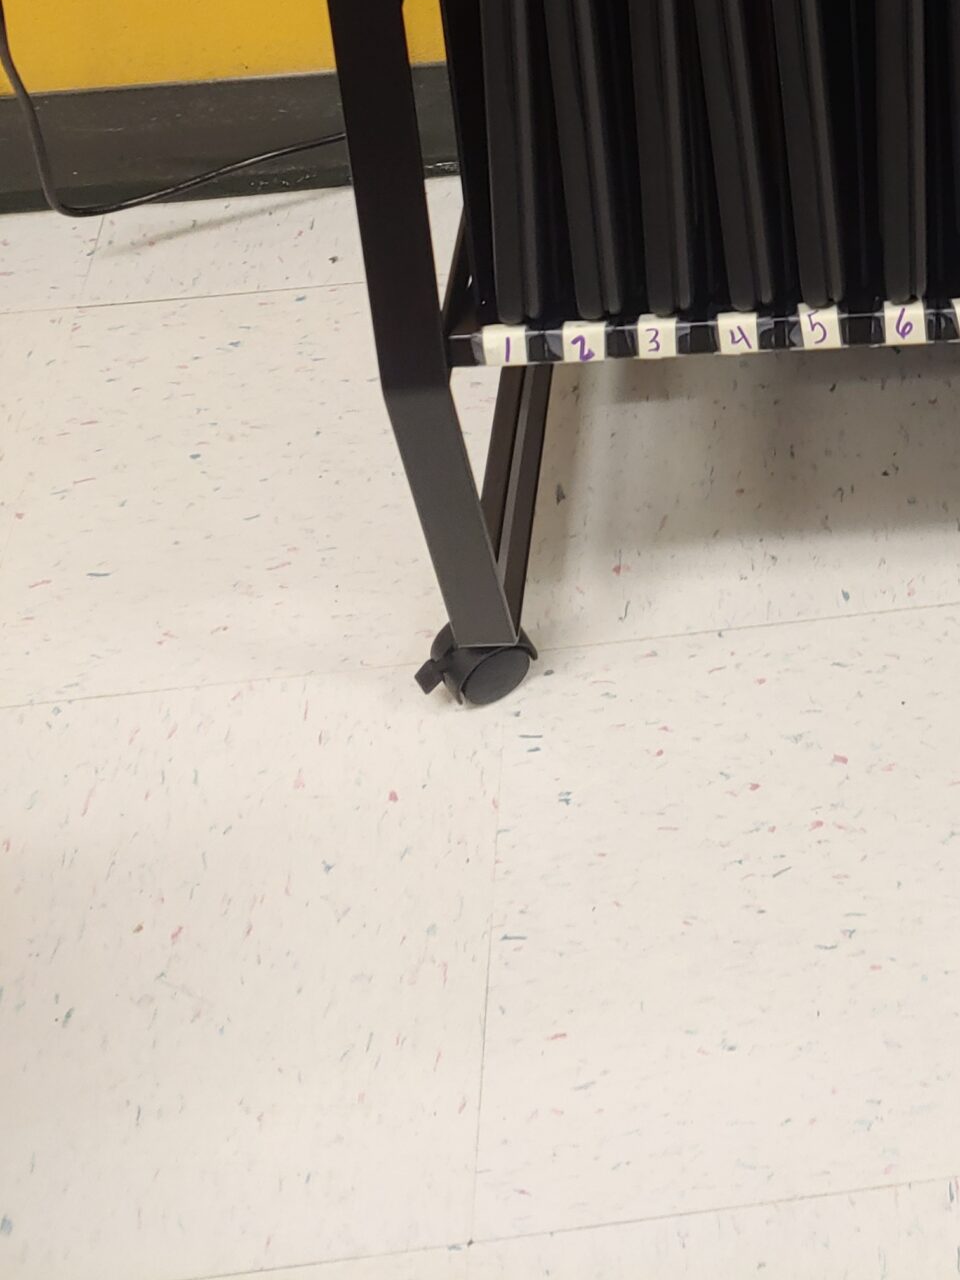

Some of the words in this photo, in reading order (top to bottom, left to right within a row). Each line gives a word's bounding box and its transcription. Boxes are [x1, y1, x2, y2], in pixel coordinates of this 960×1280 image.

[806, 309, 828, 344] 5
[894, 307, 914, 338] 6
[503, 336, 513, 363] 1
[570, 335, 595, 362] 2
[645, 328, 661, 352] 3
[729, 326, 752, 349] 4
